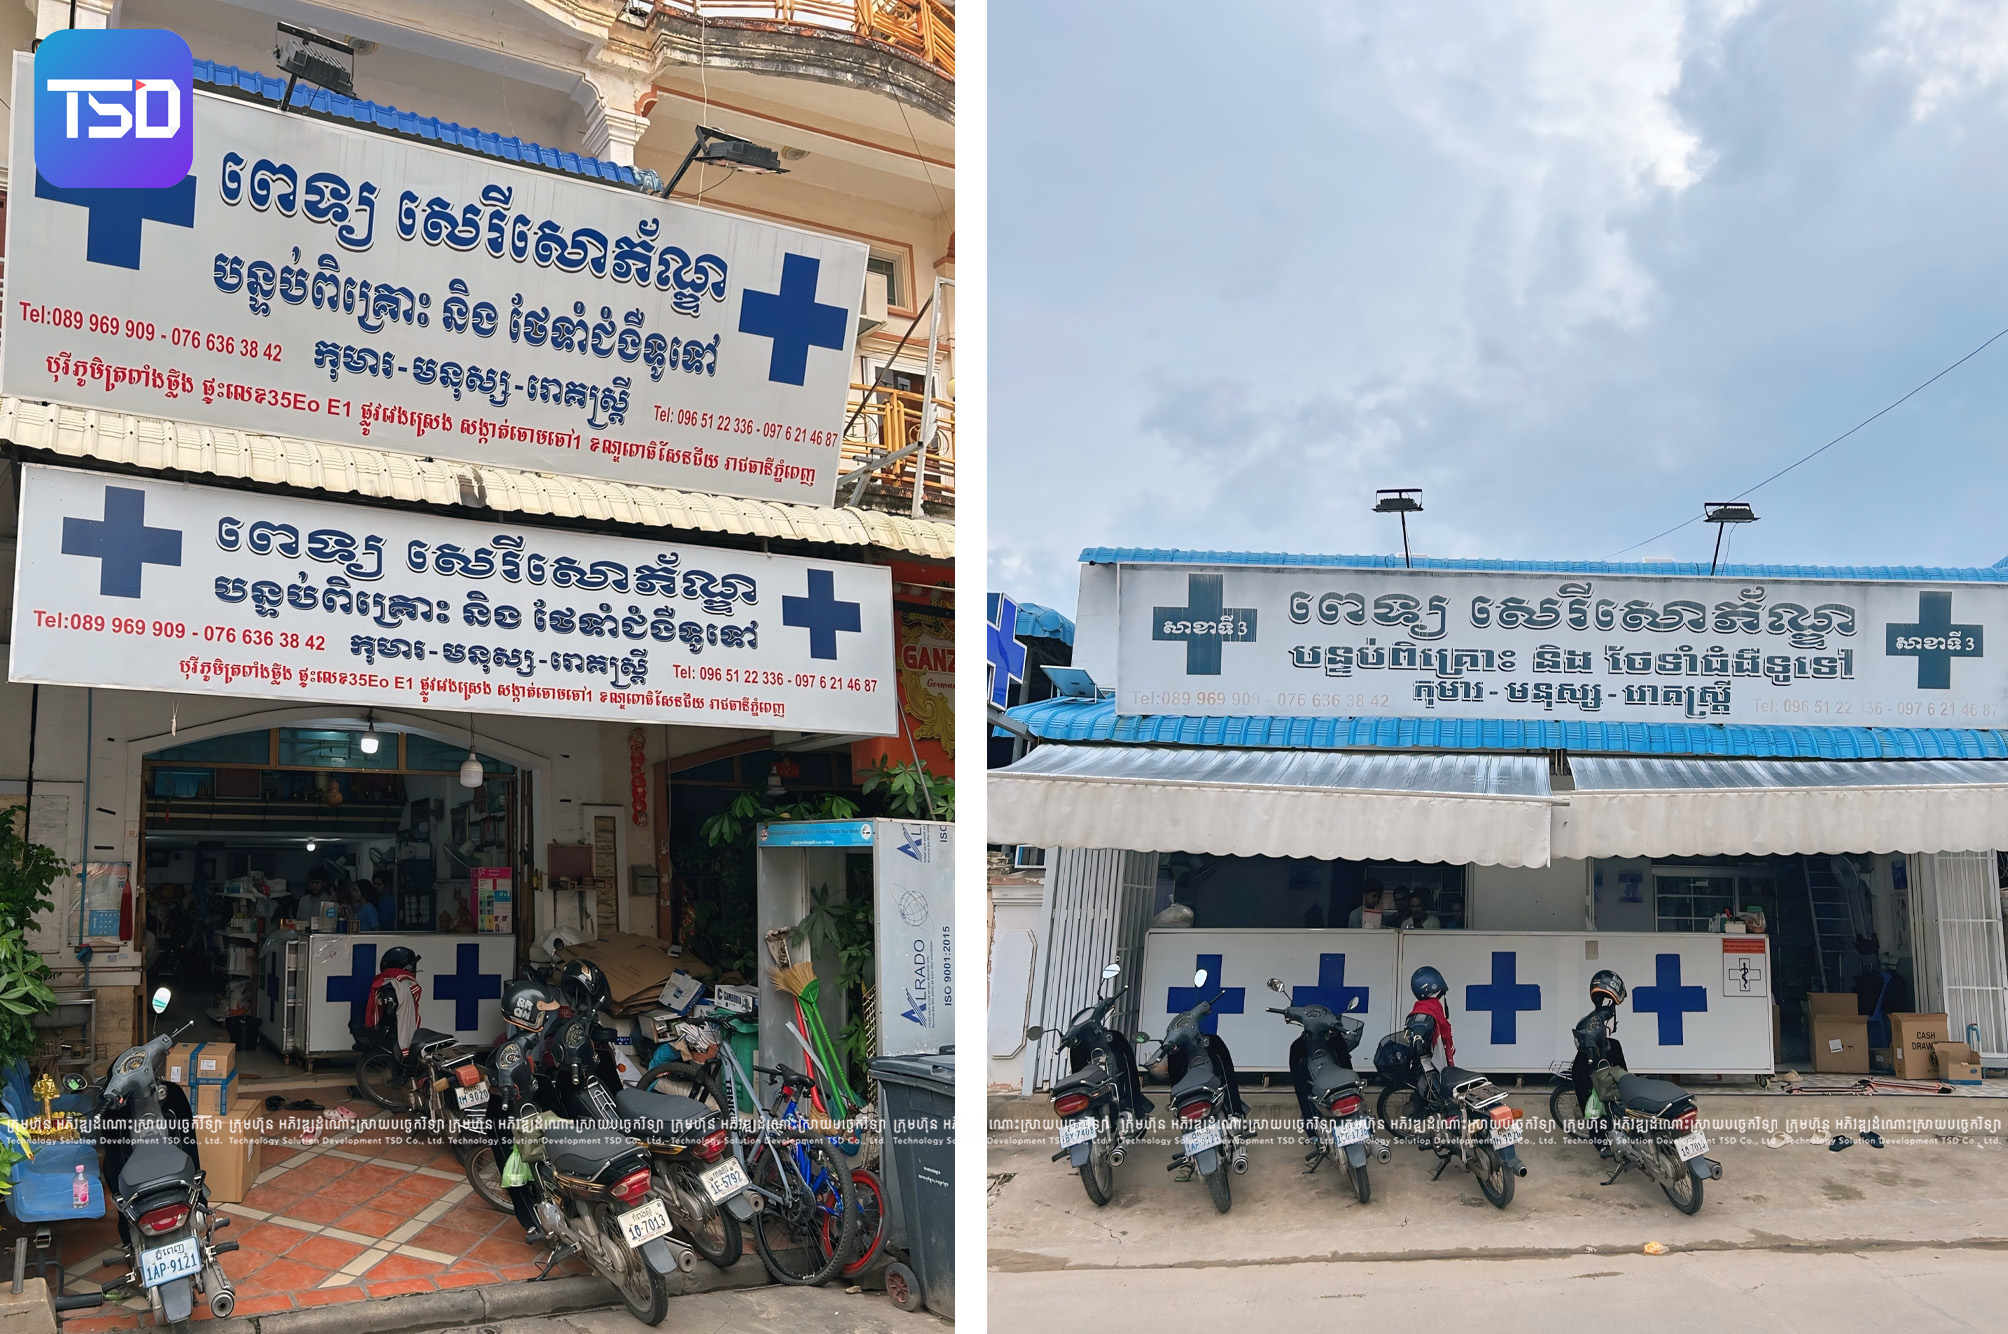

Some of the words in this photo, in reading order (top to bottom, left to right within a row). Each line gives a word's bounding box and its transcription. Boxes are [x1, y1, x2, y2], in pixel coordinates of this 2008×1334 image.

[220, 151, 379, 251] ពេទ្យ
[442, 278, 499, 337] និង
[89, 312, 120, 337] 969
[125, 318, 156, 342] 909
[172, 326, 201, 349] 076
[206, 332, 235, 355] 636
[240, 337, 260, 358] 38
[263, 341, 283, 362] 42
[327, 397, 351, 417] E1
[654, 405, 673, 424] Tel:
[677, 409, 698, 428] 096
[699, 412, 714, 429] 51
[717, 414, 731, 432] 22
[733, 417, 754, 435] 336
[763, 421, 783, 439] 097
[785, 424, 793, 441] 6
[794, 426, 808, 444] 21
[809, 427, 823, 445] 46
[825, 430, 838, 448] 87
[216, 516, 388, 581] ពេទ្យ
[463, 590, 522, 631] និង
[1287, 591, 1453, 642] ពេទ្យ
[111, 617, 146, 635] 969
[152, 620, 186, 639] 909
[204, 625, 237, 644] 076
[242, 628, 274, 647] 636
[279, 632, 300, 650] 38
[304, 634, 326, 651] 42
[1532, 643, 1593, 674] និង
[395, 676, 413, 690] E1
[672, 664, 695, 680] Tel:
[699, 666, 722, 681] 096
[726, 668, 739, 682] 51
[744, 669, 758, 684] 22
[762, 671, 784, 686] 336
[795, 672, 817, 689] 097
[819, 674, 827, 690] 6
[829, 674, 844, 691] 21
[847, 677, 862, 692] 46
[864, 678, 878, 693] 87
[1196, 691, 1226, 707] 969
[1232, 692, 1261, 707] 909
[1277, 693, 1307, 708] 076
[1311, 693, 1341, 708] 636
[1346, 694, 1365, 708] 38
[1370, 694, 1390, 709] 42
[1783, 699, 1809, 714] 096
[1814, 700, 1830, 715] 51
[1835, 700, 1852, 715] 22
[1897, 701, 1922, 716] 097
[1927, 702, 1936, 716] 6
[1939, 702, 1957, 717] 21
[1961, 703, 1978, 717] 46
[1982, 703, 1998, 718] 87
[1912, 1041, 1934, 1050] DRAW
[1916, 1031, 1936, 1040] CASH
